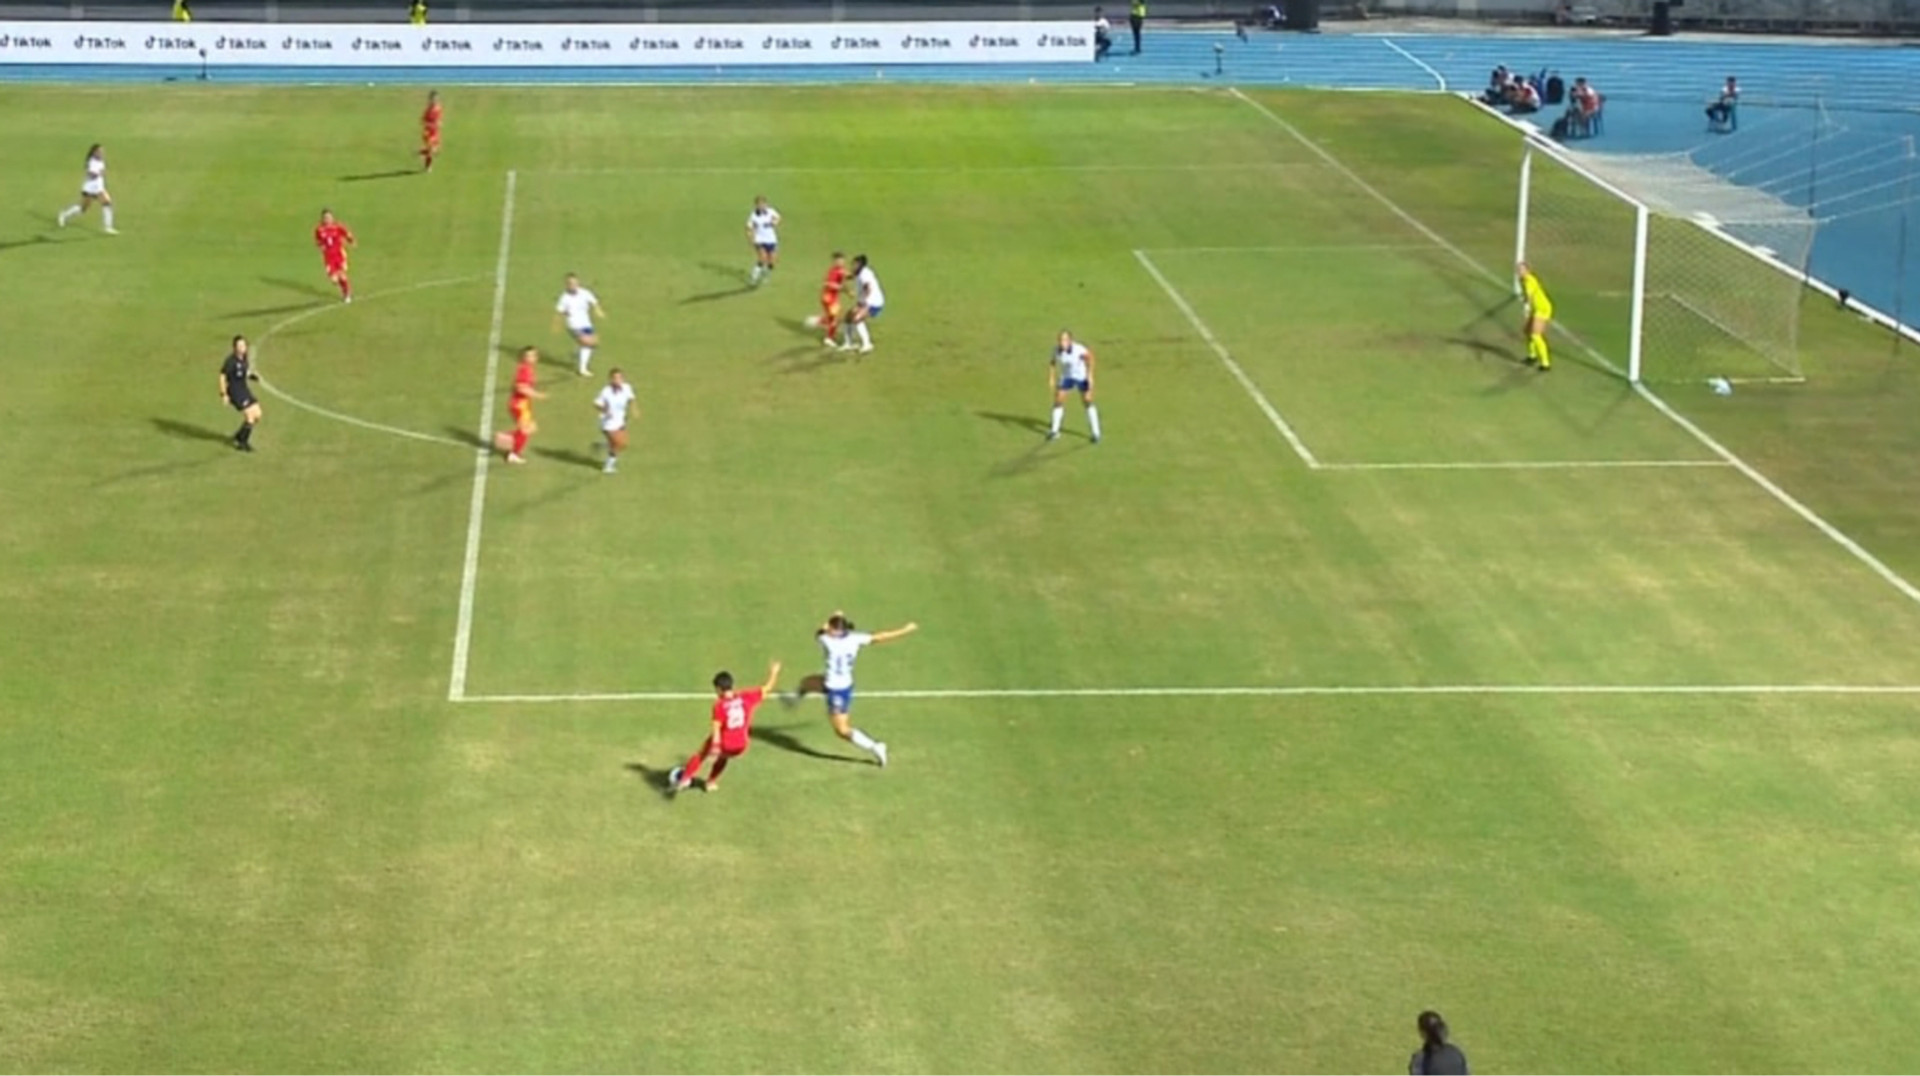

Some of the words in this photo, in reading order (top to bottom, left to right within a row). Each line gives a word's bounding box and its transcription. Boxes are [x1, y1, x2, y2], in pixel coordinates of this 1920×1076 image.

[13, 37, 51, 47] TikTok
[87, 37, 125, 48] TikTok
[159, 37, 197, 49] TikTok
[229, 39, 267, 49] TikTok
[296, 39, 333, 49] TikTok
[365, 39, 403, 50] TikTok
[435, 39, 472, 50] TikTok
[506, 39, 544, 50] TikTok
[575, 39, 611, 50] TikTok
[643, 39, 680, 49] TikTok
[708, 39, 744, 49] TikTok
[776, 38, 812, 49] TikTok
[844, 38, 881, 48] TikTok
[914, 37, 951, 48] TikTok
[982, 37, 1019, 48] TikTok
[1051, 37, 1087, 47] TikTok
